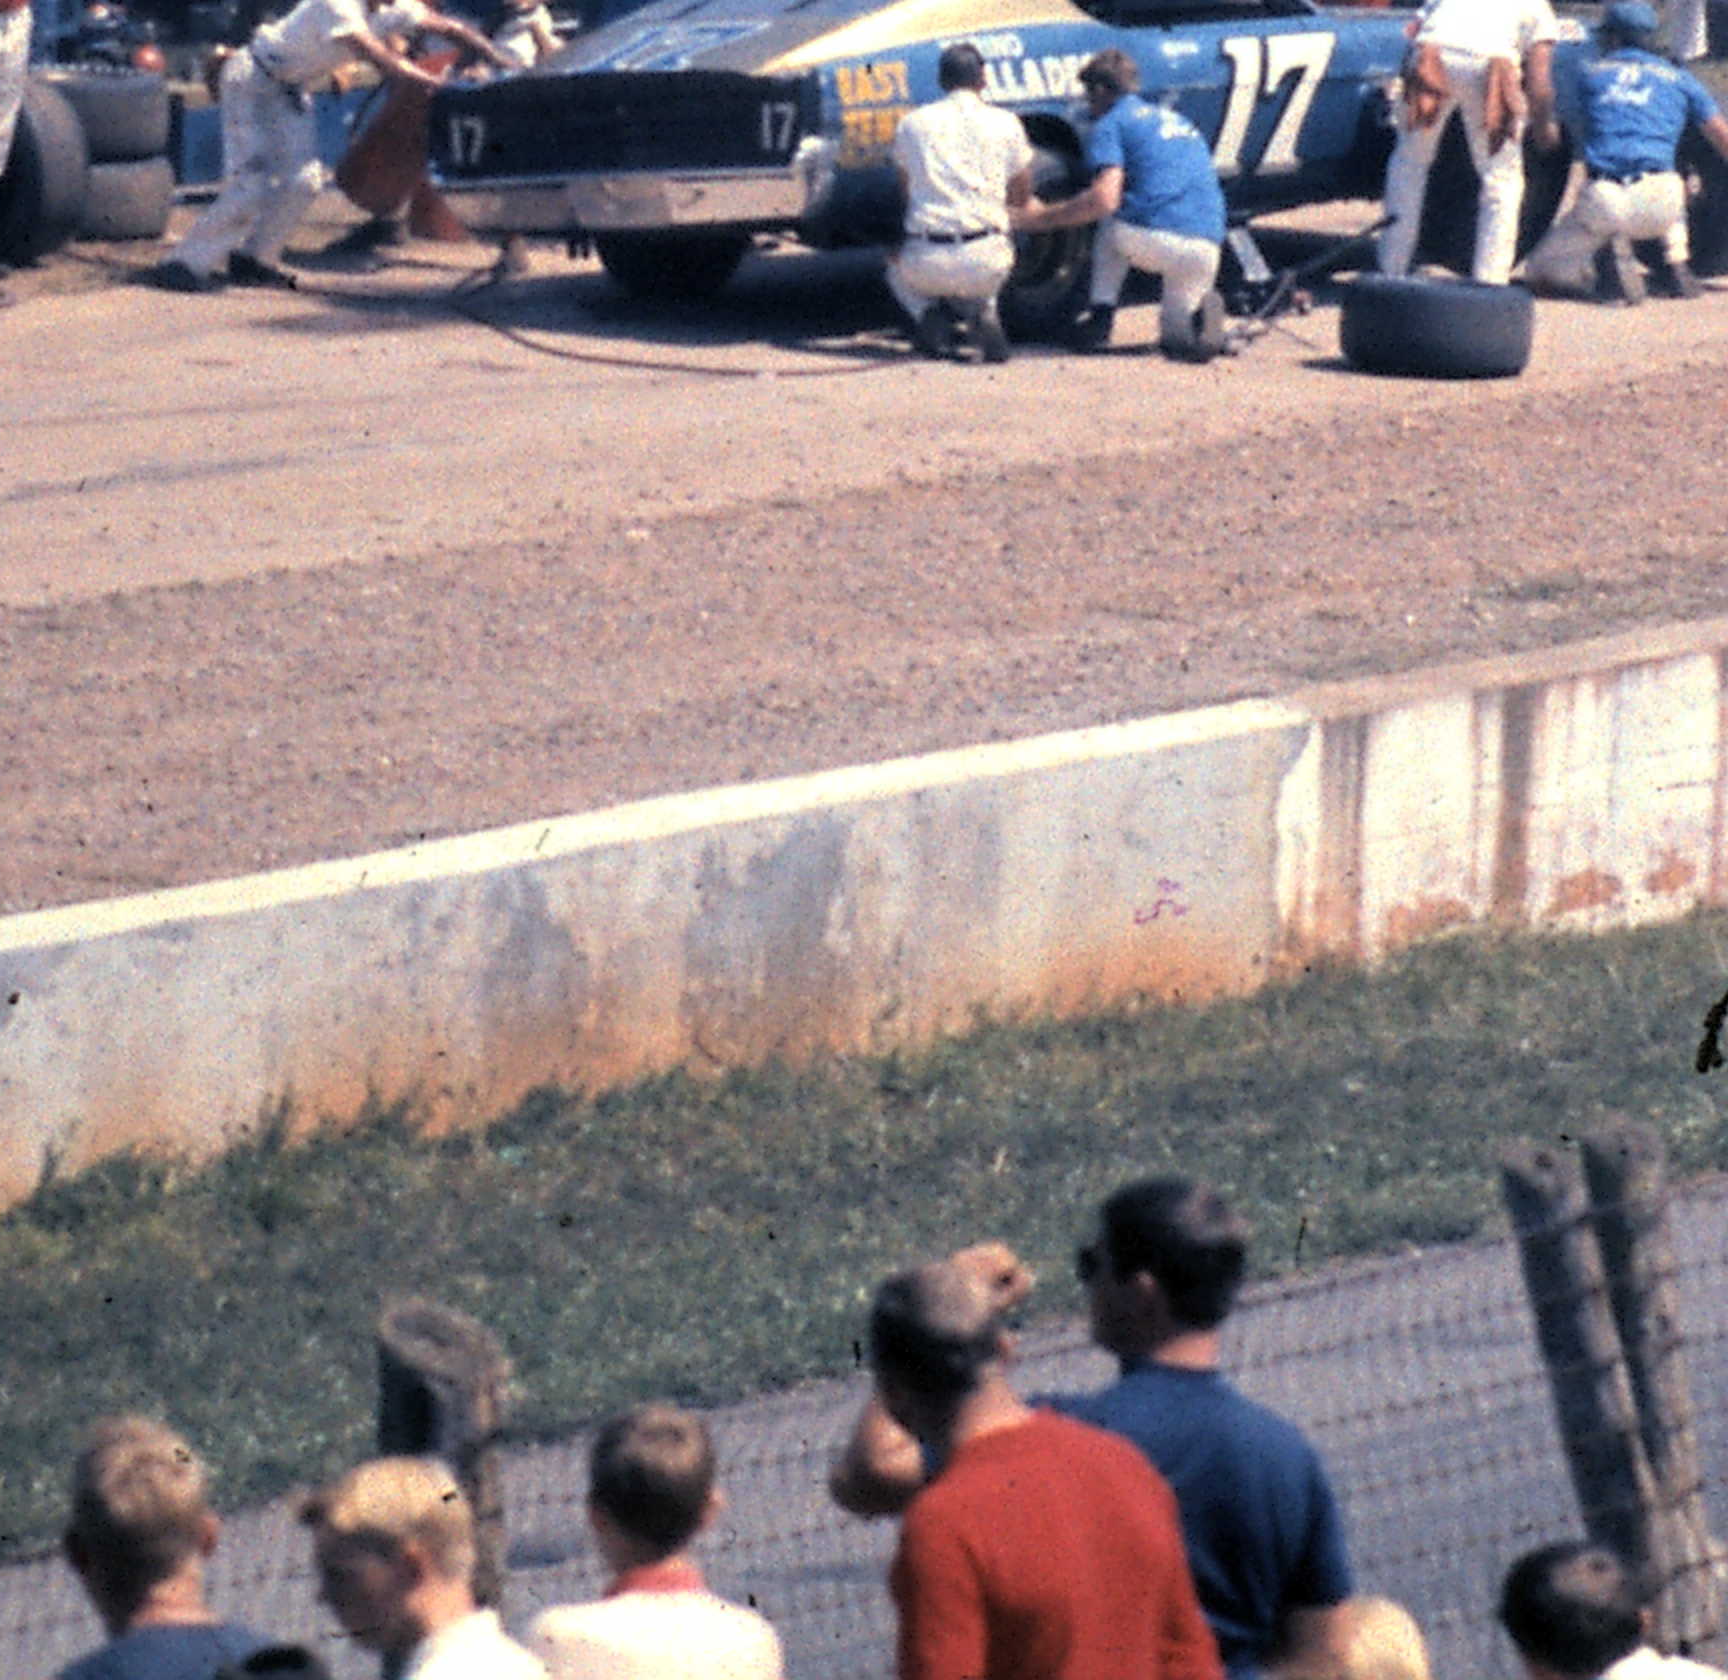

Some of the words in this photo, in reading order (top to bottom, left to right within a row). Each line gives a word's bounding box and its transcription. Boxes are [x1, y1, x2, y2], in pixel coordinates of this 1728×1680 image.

[759, 101, 797, 152] 17
[1214, 32, 1336, 176] 17
[450, 117, 485, 166] 17
